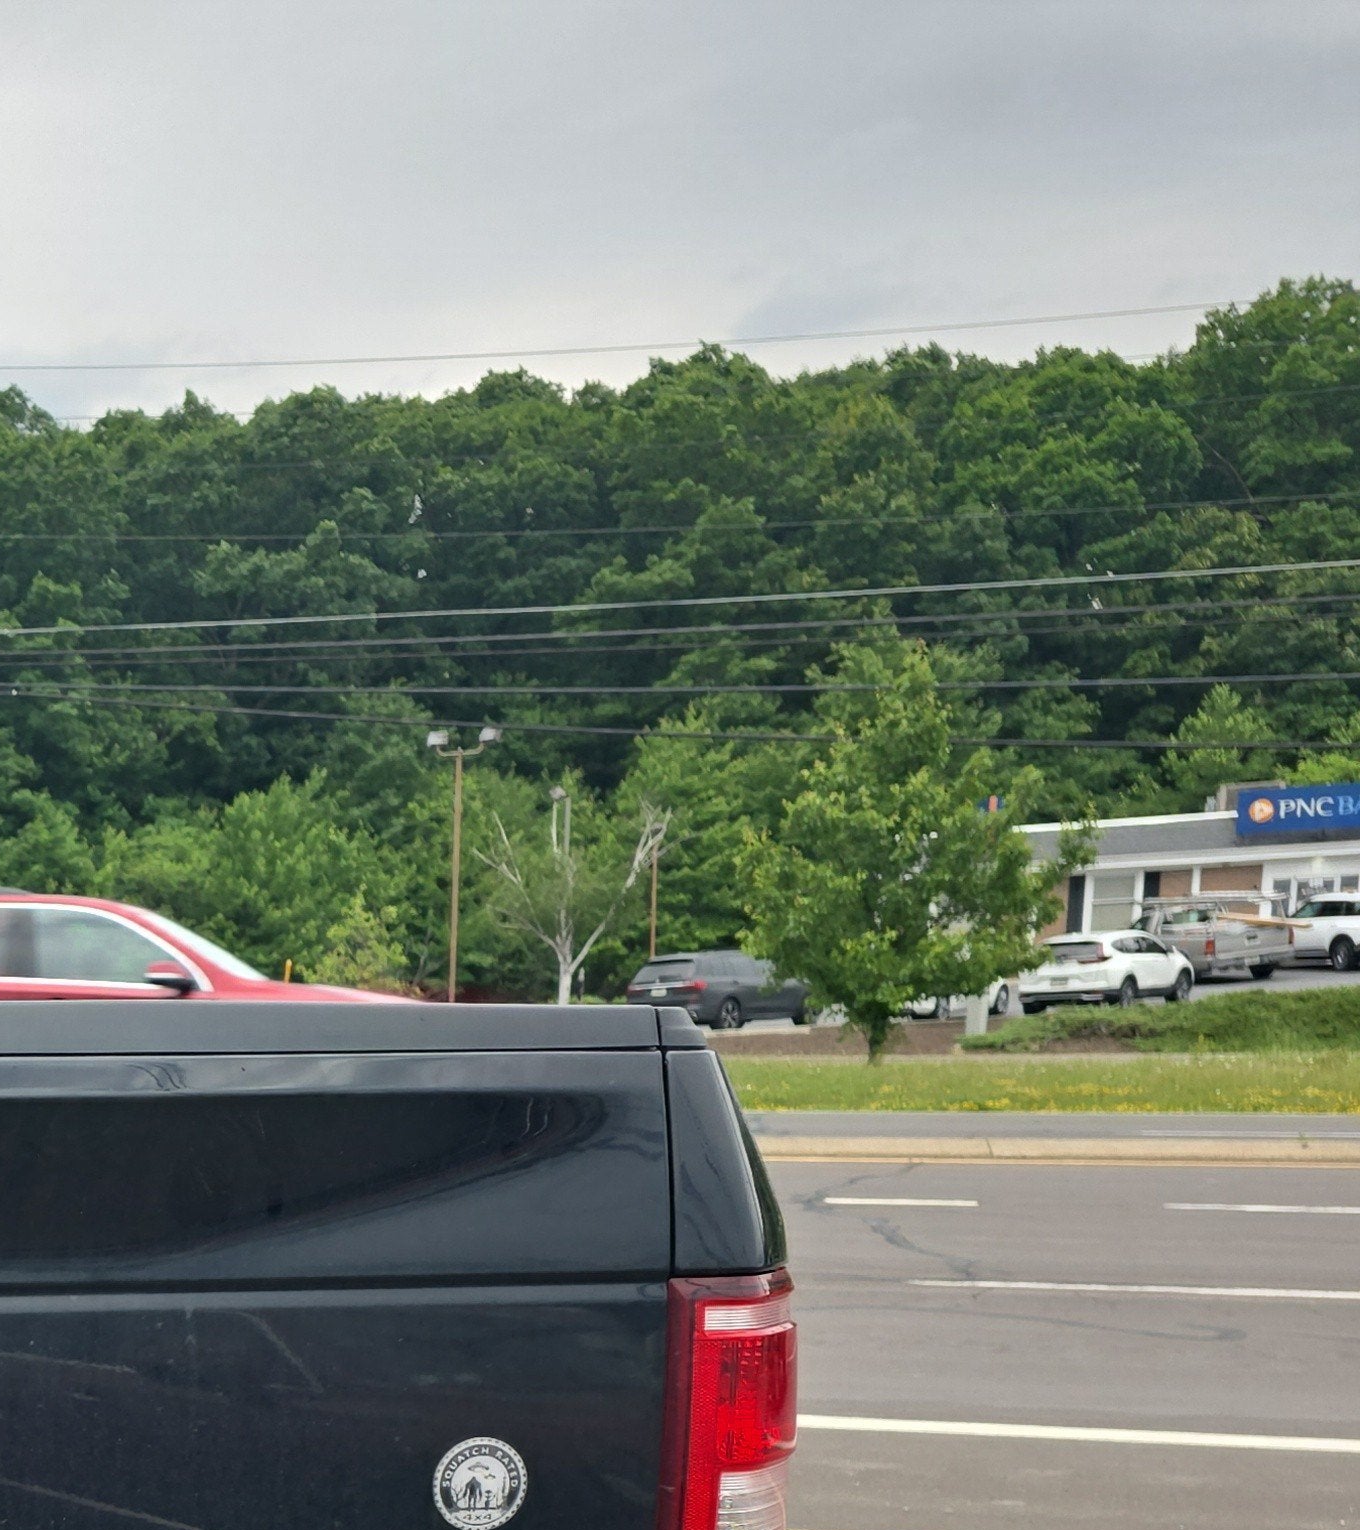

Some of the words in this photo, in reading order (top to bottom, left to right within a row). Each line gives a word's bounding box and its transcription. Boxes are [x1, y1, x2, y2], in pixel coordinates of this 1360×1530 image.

[1278, 796, 1335, 819] PNC
[442, 1447, 490, 1488] SQUATCH
[494, 1450, 519, 1488] RATED
